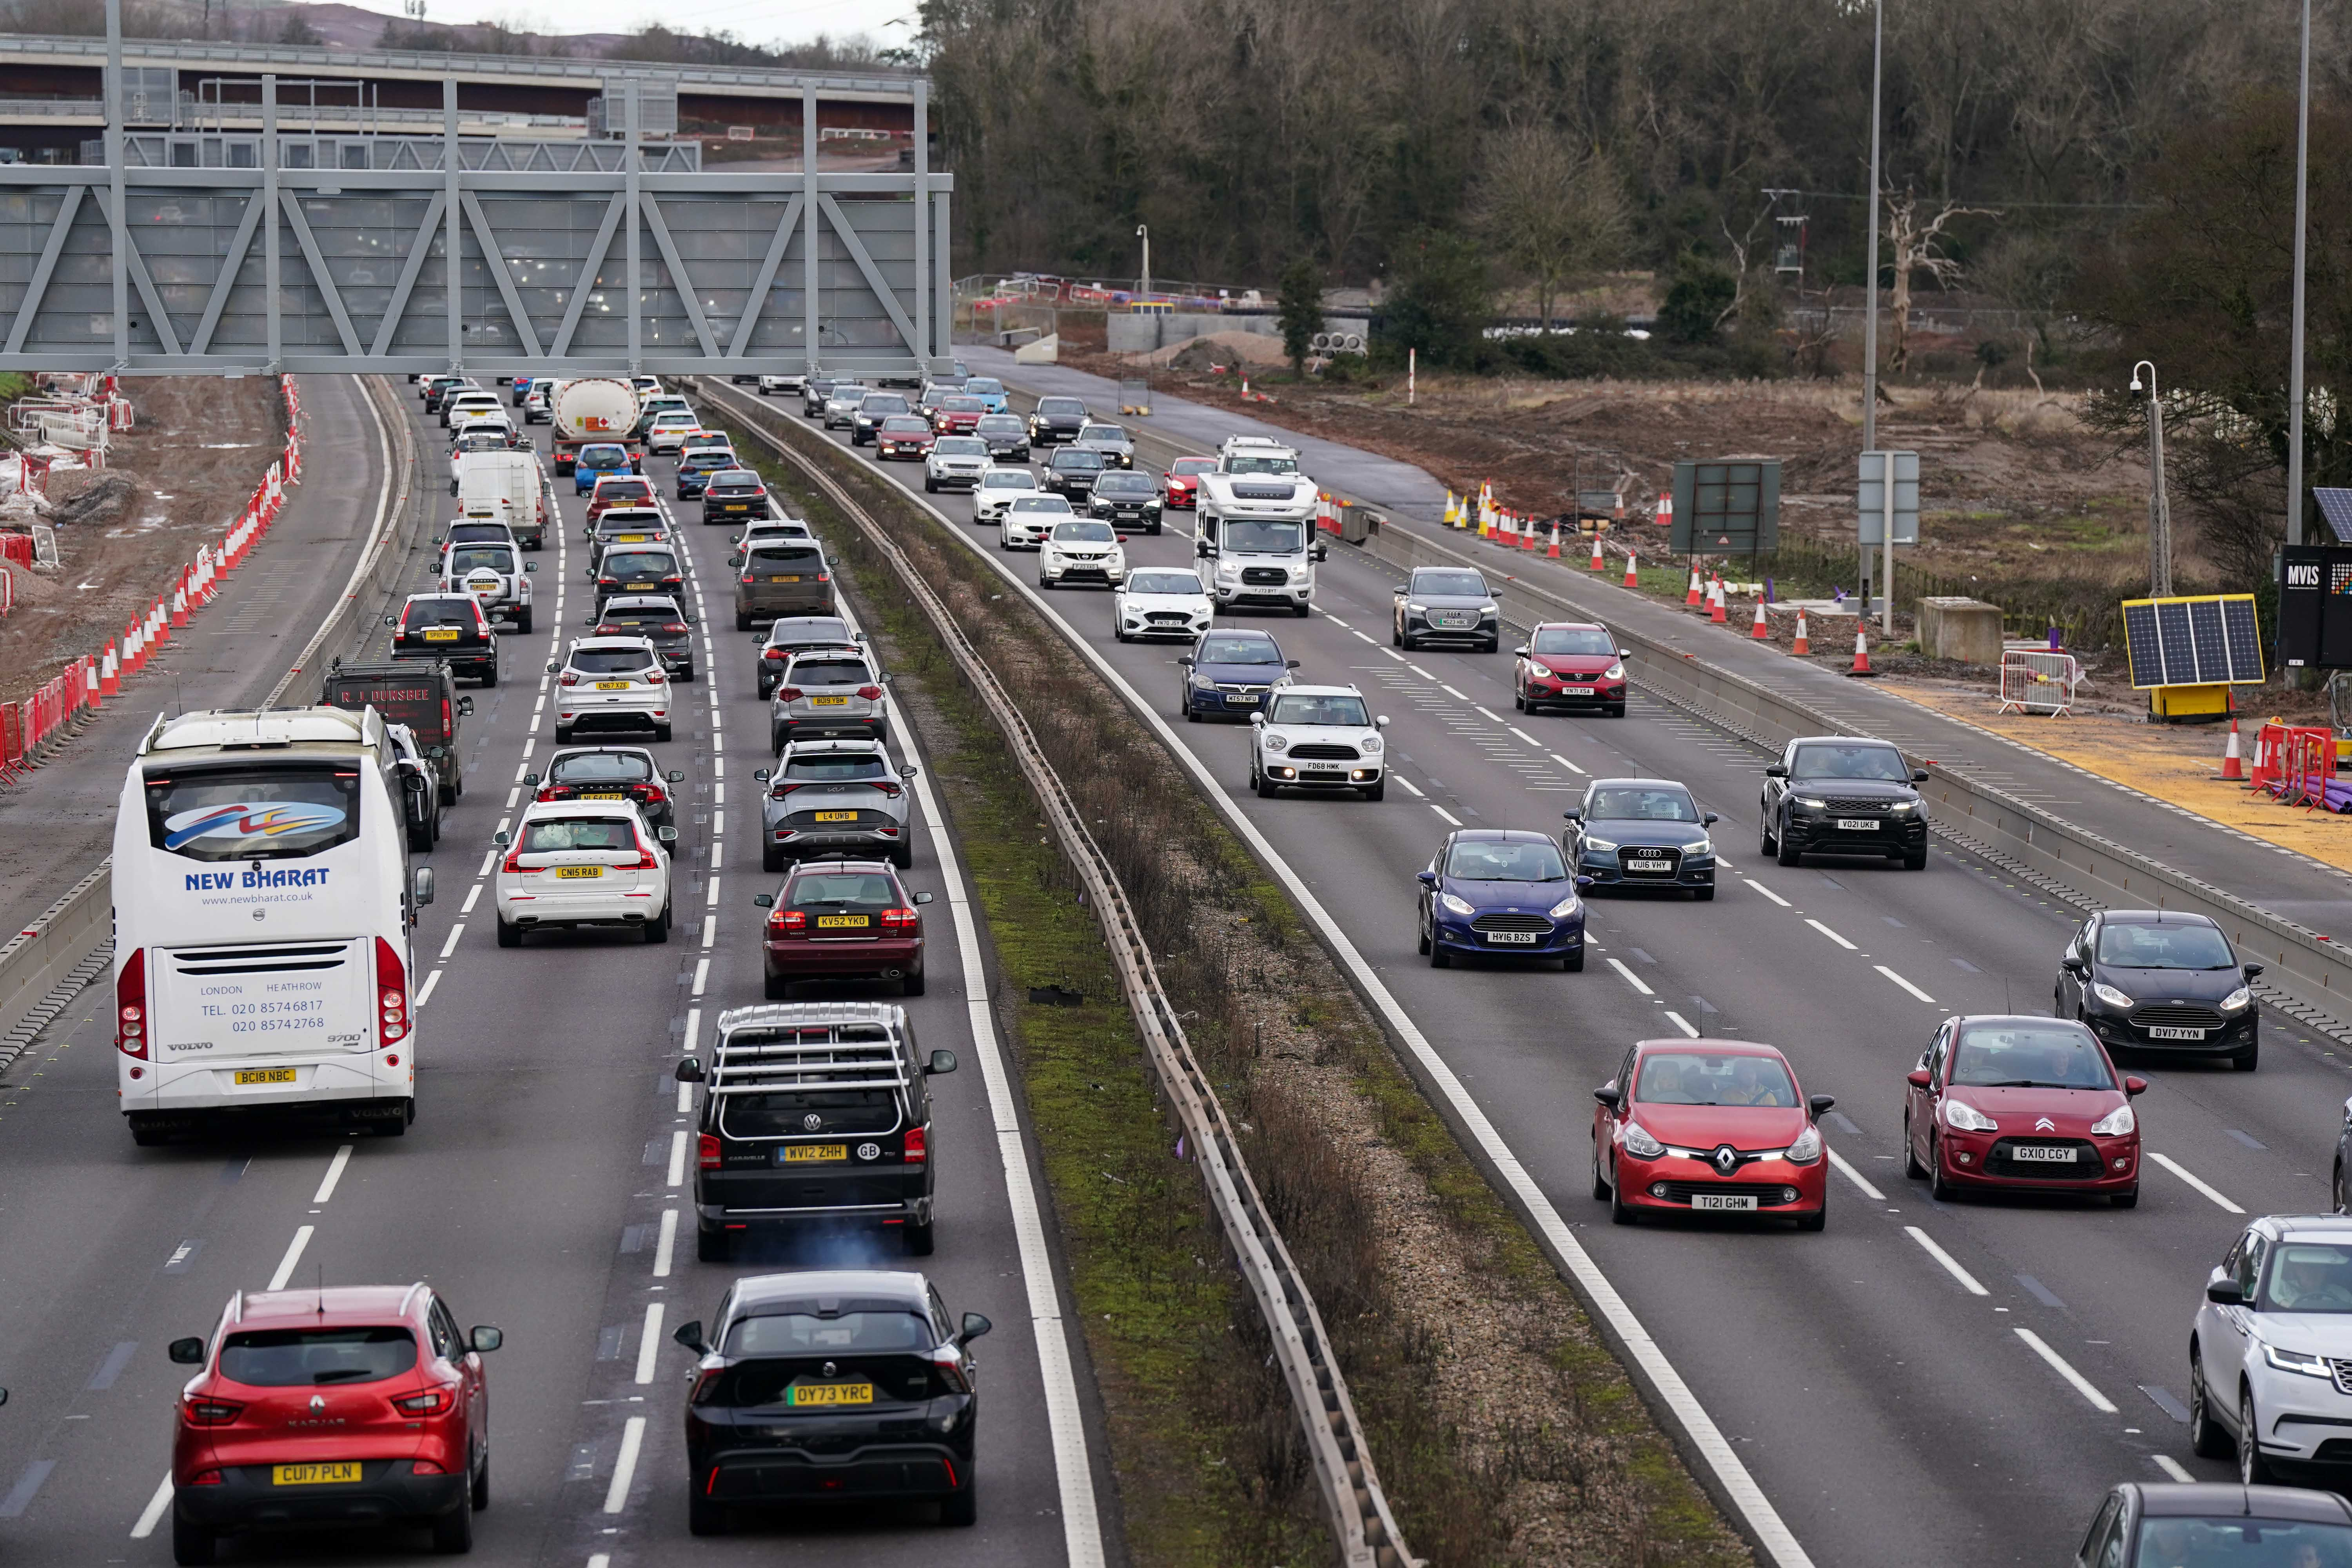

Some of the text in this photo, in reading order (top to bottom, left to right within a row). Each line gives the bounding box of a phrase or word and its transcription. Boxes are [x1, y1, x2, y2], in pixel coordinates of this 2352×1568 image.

[2288, 565, 2319, 585] MVIS
[372, 688, 429, 702] DUNSBEE
[185, 868, 330, 890] NEW BHARAT
[202, 891, 313, 905] www.newbharat.co.uk
[822, 917, 845, 926] KV52
[201, 986, 243, 995] LONDON
[201, 1005, 226, 1016] TEL.
[232, 1004, 256, 1014] 020
[232, 1021, 256, 1032] 020
[327, 1034, 361, 1042] 9700
[2156, 1028, 2199, 1038] DV17 YYN
[167, 1042, 213, 1051] VOLVO
[241, 1071, 290, 1083] BC18 NBC
[789, 1146, 842, 1159] WV12 ZHH
[860, 1146, 877, 1156] GB
[2020, 1148, 2070, 1160] GX10 CGY
[1701, 1197, 1748, 1209] T121 GHM
[798, 1386, 869, 1401] OY73 YRC
[288, 1418, 345, 1427] KADJAR
[283, 1464, 352, 1482] CU17 PLN
